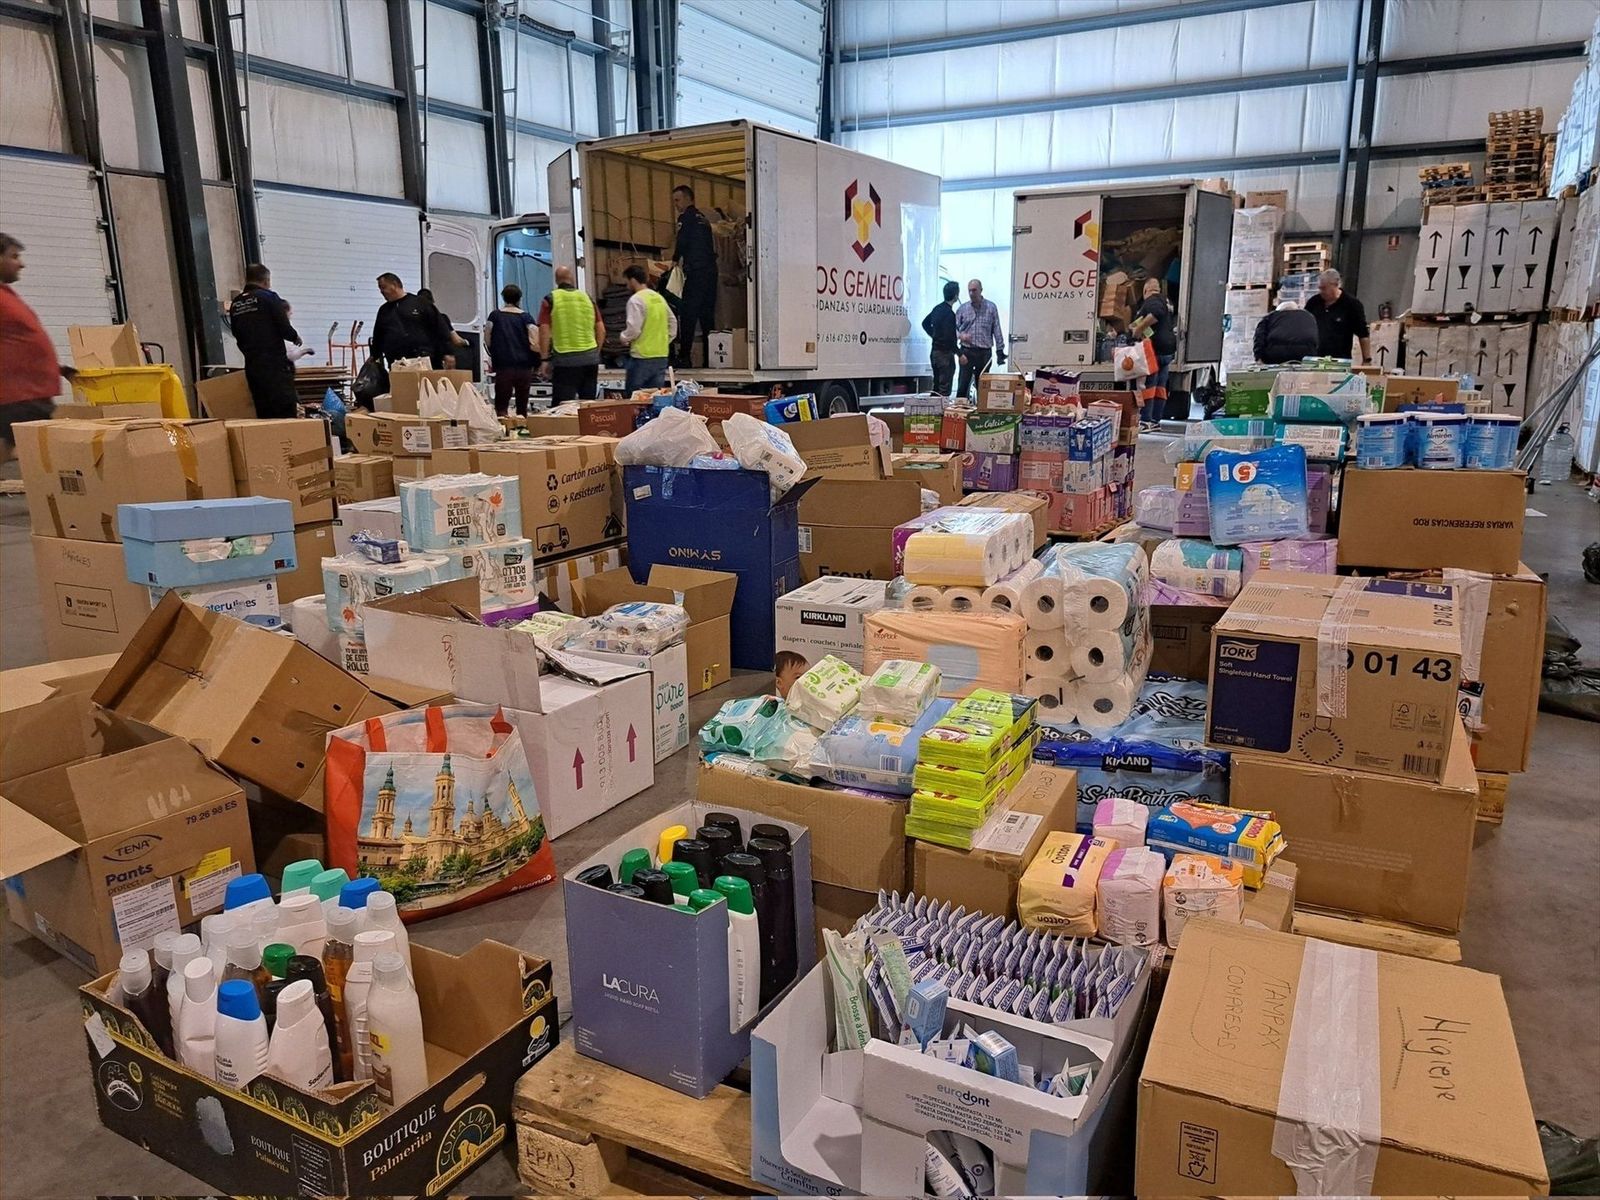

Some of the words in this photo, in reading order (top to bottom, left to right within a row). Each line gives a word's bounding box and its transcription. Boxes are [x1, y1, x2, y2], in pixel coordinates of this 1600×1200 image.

[817, 266, 838, 295] OS
[843, 269, 905, 301] GEMELO
[1023, 271, 1061, 289] LOS
[1069, 270, 1097, 288] GE
[1022, 290, 1076, 300] MUDANZAS
[1078, 291, 1084, 299] Y
[1086, 290, 1095, 299] G
[702, 402, 732, 415] Pascual
[590, 412, 617, 424] Pascual
[560, 467, 587, 486] Cartón
[1181, 473, 1189, 484] 3
[1237, 465, 1251, 481] 5
[569, 482, 606, 504] Resistente
[447, 509, 456, 517] DE
[456, 508, 470, 516] ESTE
[447, 514, 472, 527] ROLLO
[1431, 517, 1486, 529] REFERENCIAS
[1486, 519, 1514, 529] VARIAS
[502, 565, 526, 576] ROLLO
[266, 617, 276, 626] 12
[803, 611, 845, 623] KIRKLAND
[782, 634, 806, 644] diapers
[809, 638, 836, 647] couches
[1222, 646, 1255, 658] TORK
[346, 662, 369, 672] ROLLO
[1218, 667, 1252, 677] Singlefold
[1253, 671, 1271, 679] Hand
[1272, 674, 1293, 682] Towel
[1363, 650, 1399, 677] 01
[1411, 657, 1452, 683] 43
[655, 682, 686, 715] pure
[1121, 785, 1163, 808] Bath
[185, 817, 198, 825] 79
[199, 810, 210, 821] 26
[211, 806, 224, 817] 98
[225, 800, 238, 811] ES
[116, 840, 150, 857] TENA
[1051, 844, 1073, 865] Cotton
[105, 864, 154, 887] Pants
[107, 879, 142, 895] protect
[1037, 915, 1071, 926] Cotton
[602, 973, 660, 1005] LACURA
[619, 997, 633, 1005] HAND
[849, 995, 862, 1023] Brosse
[1216, 964, 1247, 1051] COMPRESAS
[1257, 978, 1292, 1050] TAMPAX
[936, 1083, 991, 1108] eurodont
[920, 1104, 937, 1116] PASTA
[920, 1110, 937, 1122] PASTA
[955, 1109, 974, 1122] PASTA
[972, 1115, 981, 1124] DO
[1003, 1125, 1014, 1134] 125
[1014, 1128, 1024, 1137] ML
[362, 1104, 437, 1168] BOUTIQUE
[439, 1109, 493, 1167] COPALMA
[250, 1135, 292, 1163] BOUTIQUE
[370, 1131, 433, 1182] Palmerita
[255, 1150, 290, 1174] Palmerita
[780, 1171, 820, 1194] Comfort
